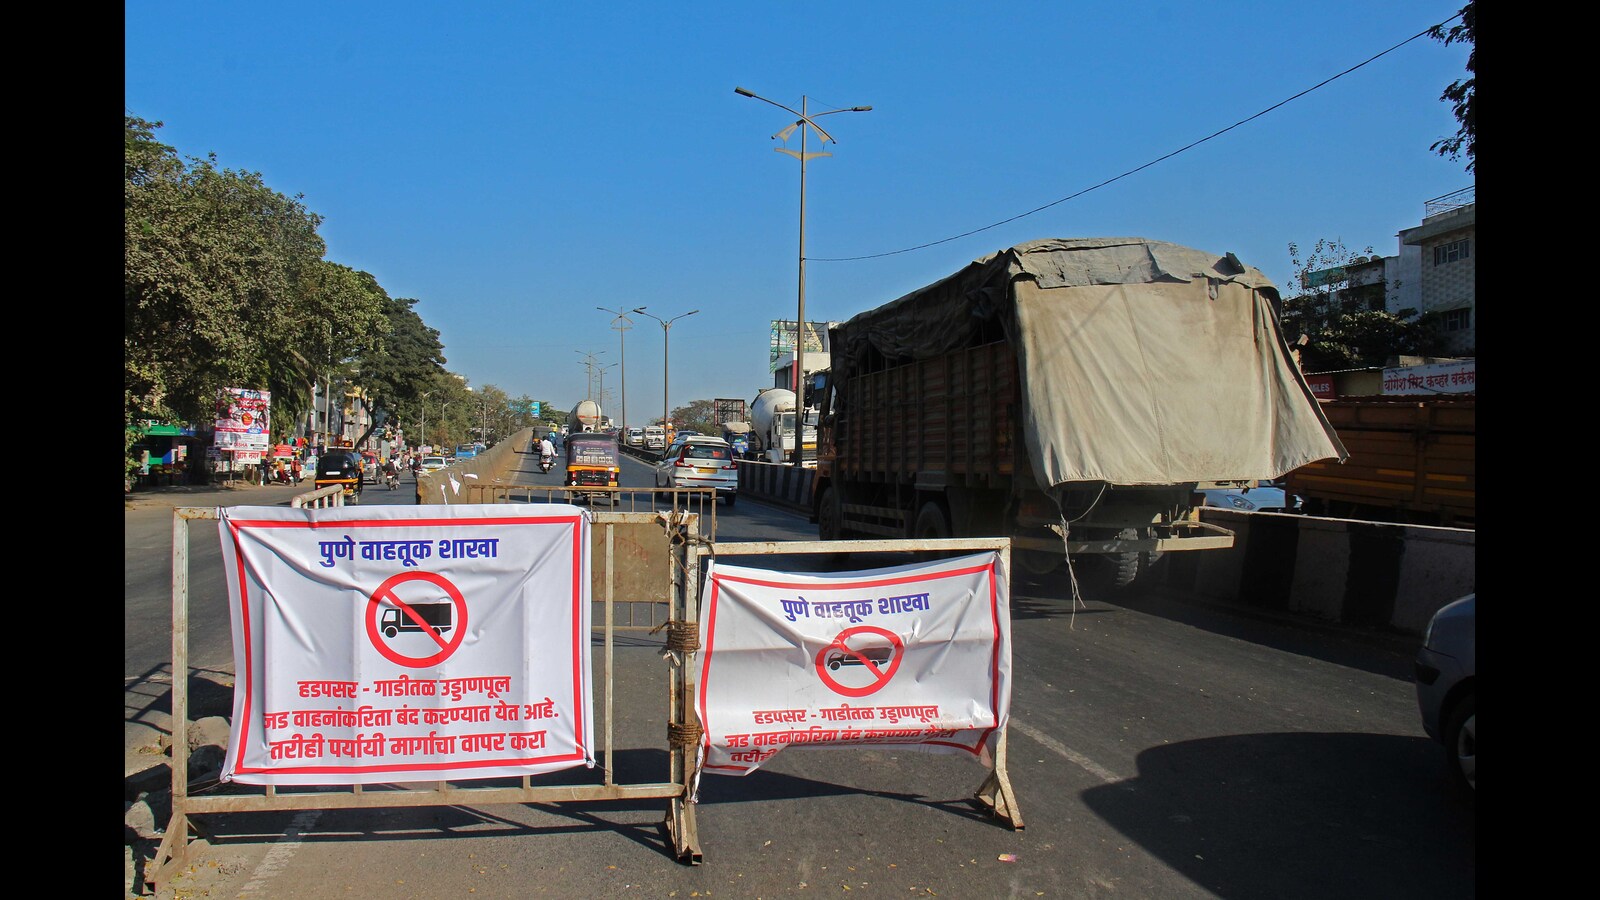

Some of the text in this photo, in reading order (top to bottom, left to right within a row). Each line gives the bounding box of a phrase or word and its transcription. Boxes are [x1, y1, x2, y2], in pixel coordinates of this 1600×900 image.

[1384, 374, 1406, 392] योगेश
[319, 535, 500, 568] पुणे वाहतूक शाखा
[780, 592, 930, 624] पुणे वाहतूक शाखा
[297, 680, 359, 699] हडपसर
[373, 673, 437, 698] गाडीतळ
[439, 676, 512, 702] उड्डाणपूल
[263, 711, 288, 731] जड
[293, 704, 392, 729] वाहनांकरिता
[395, 703, 419, 726] बंद
[422, 704, 491, 726] करण्यात
[494, 699, 520, 721] येत
[751, 709, 808, 725] हडपसर
[820, 703, 875, 722] गाडीतळ
[875, 705, 940, 725] उड्डाणपूल
[267, 729, 547, 761] तरीही पर्यायी मार्गाचा वापर करा
[724, 733, 750, 749] जड
